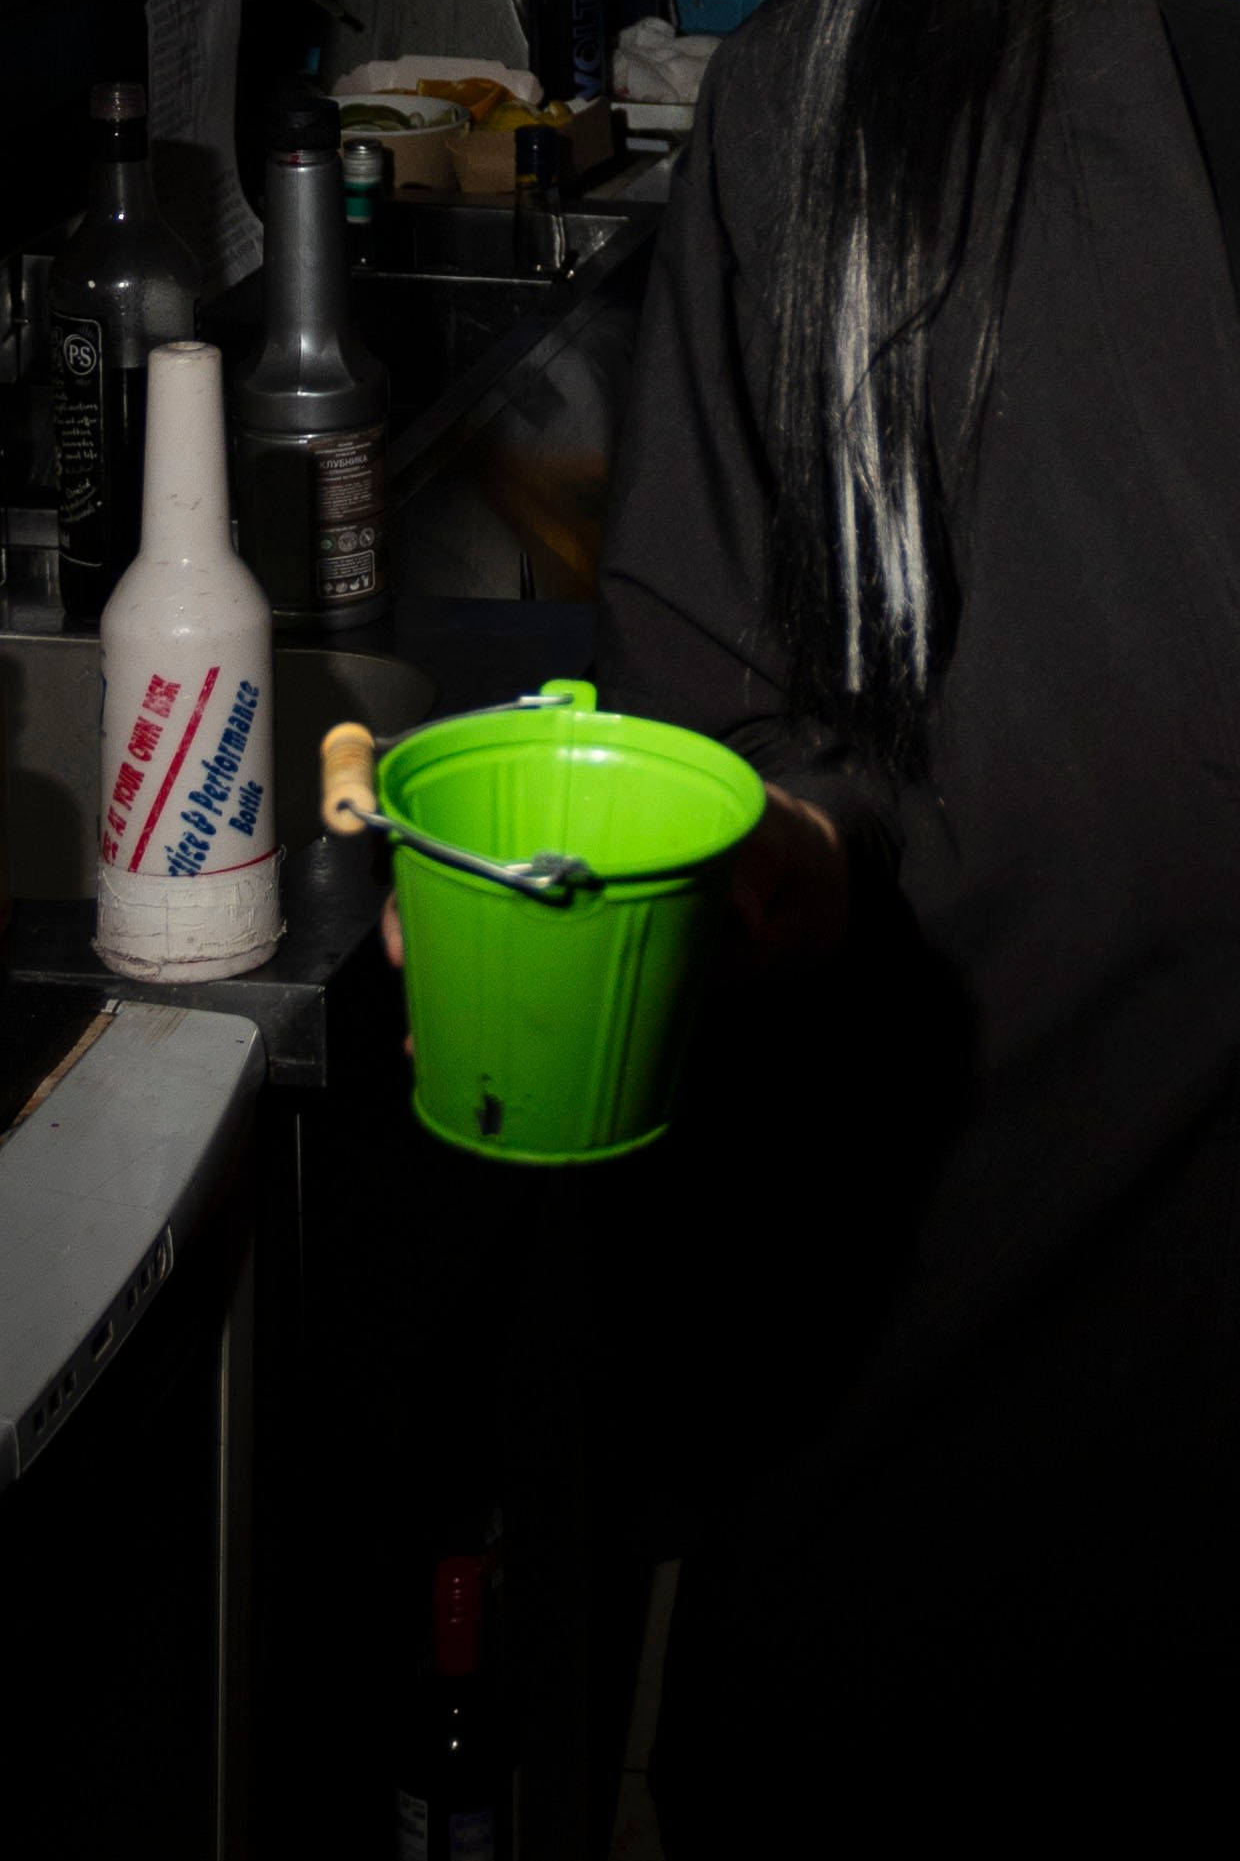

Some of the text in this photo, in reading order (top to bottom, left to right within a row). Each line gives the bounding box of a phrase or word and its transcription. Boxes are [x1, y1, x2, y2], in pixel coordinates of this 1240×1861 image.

[142, 674, 182, 719] RISK
[128, 716, 163, 762] OWN
[188, 681, 260, 816] Performance
[113, 762, 145, 811] YOUR
[228, 781, 264, 837] Bottle
[108, 804, 127, 837] AT
